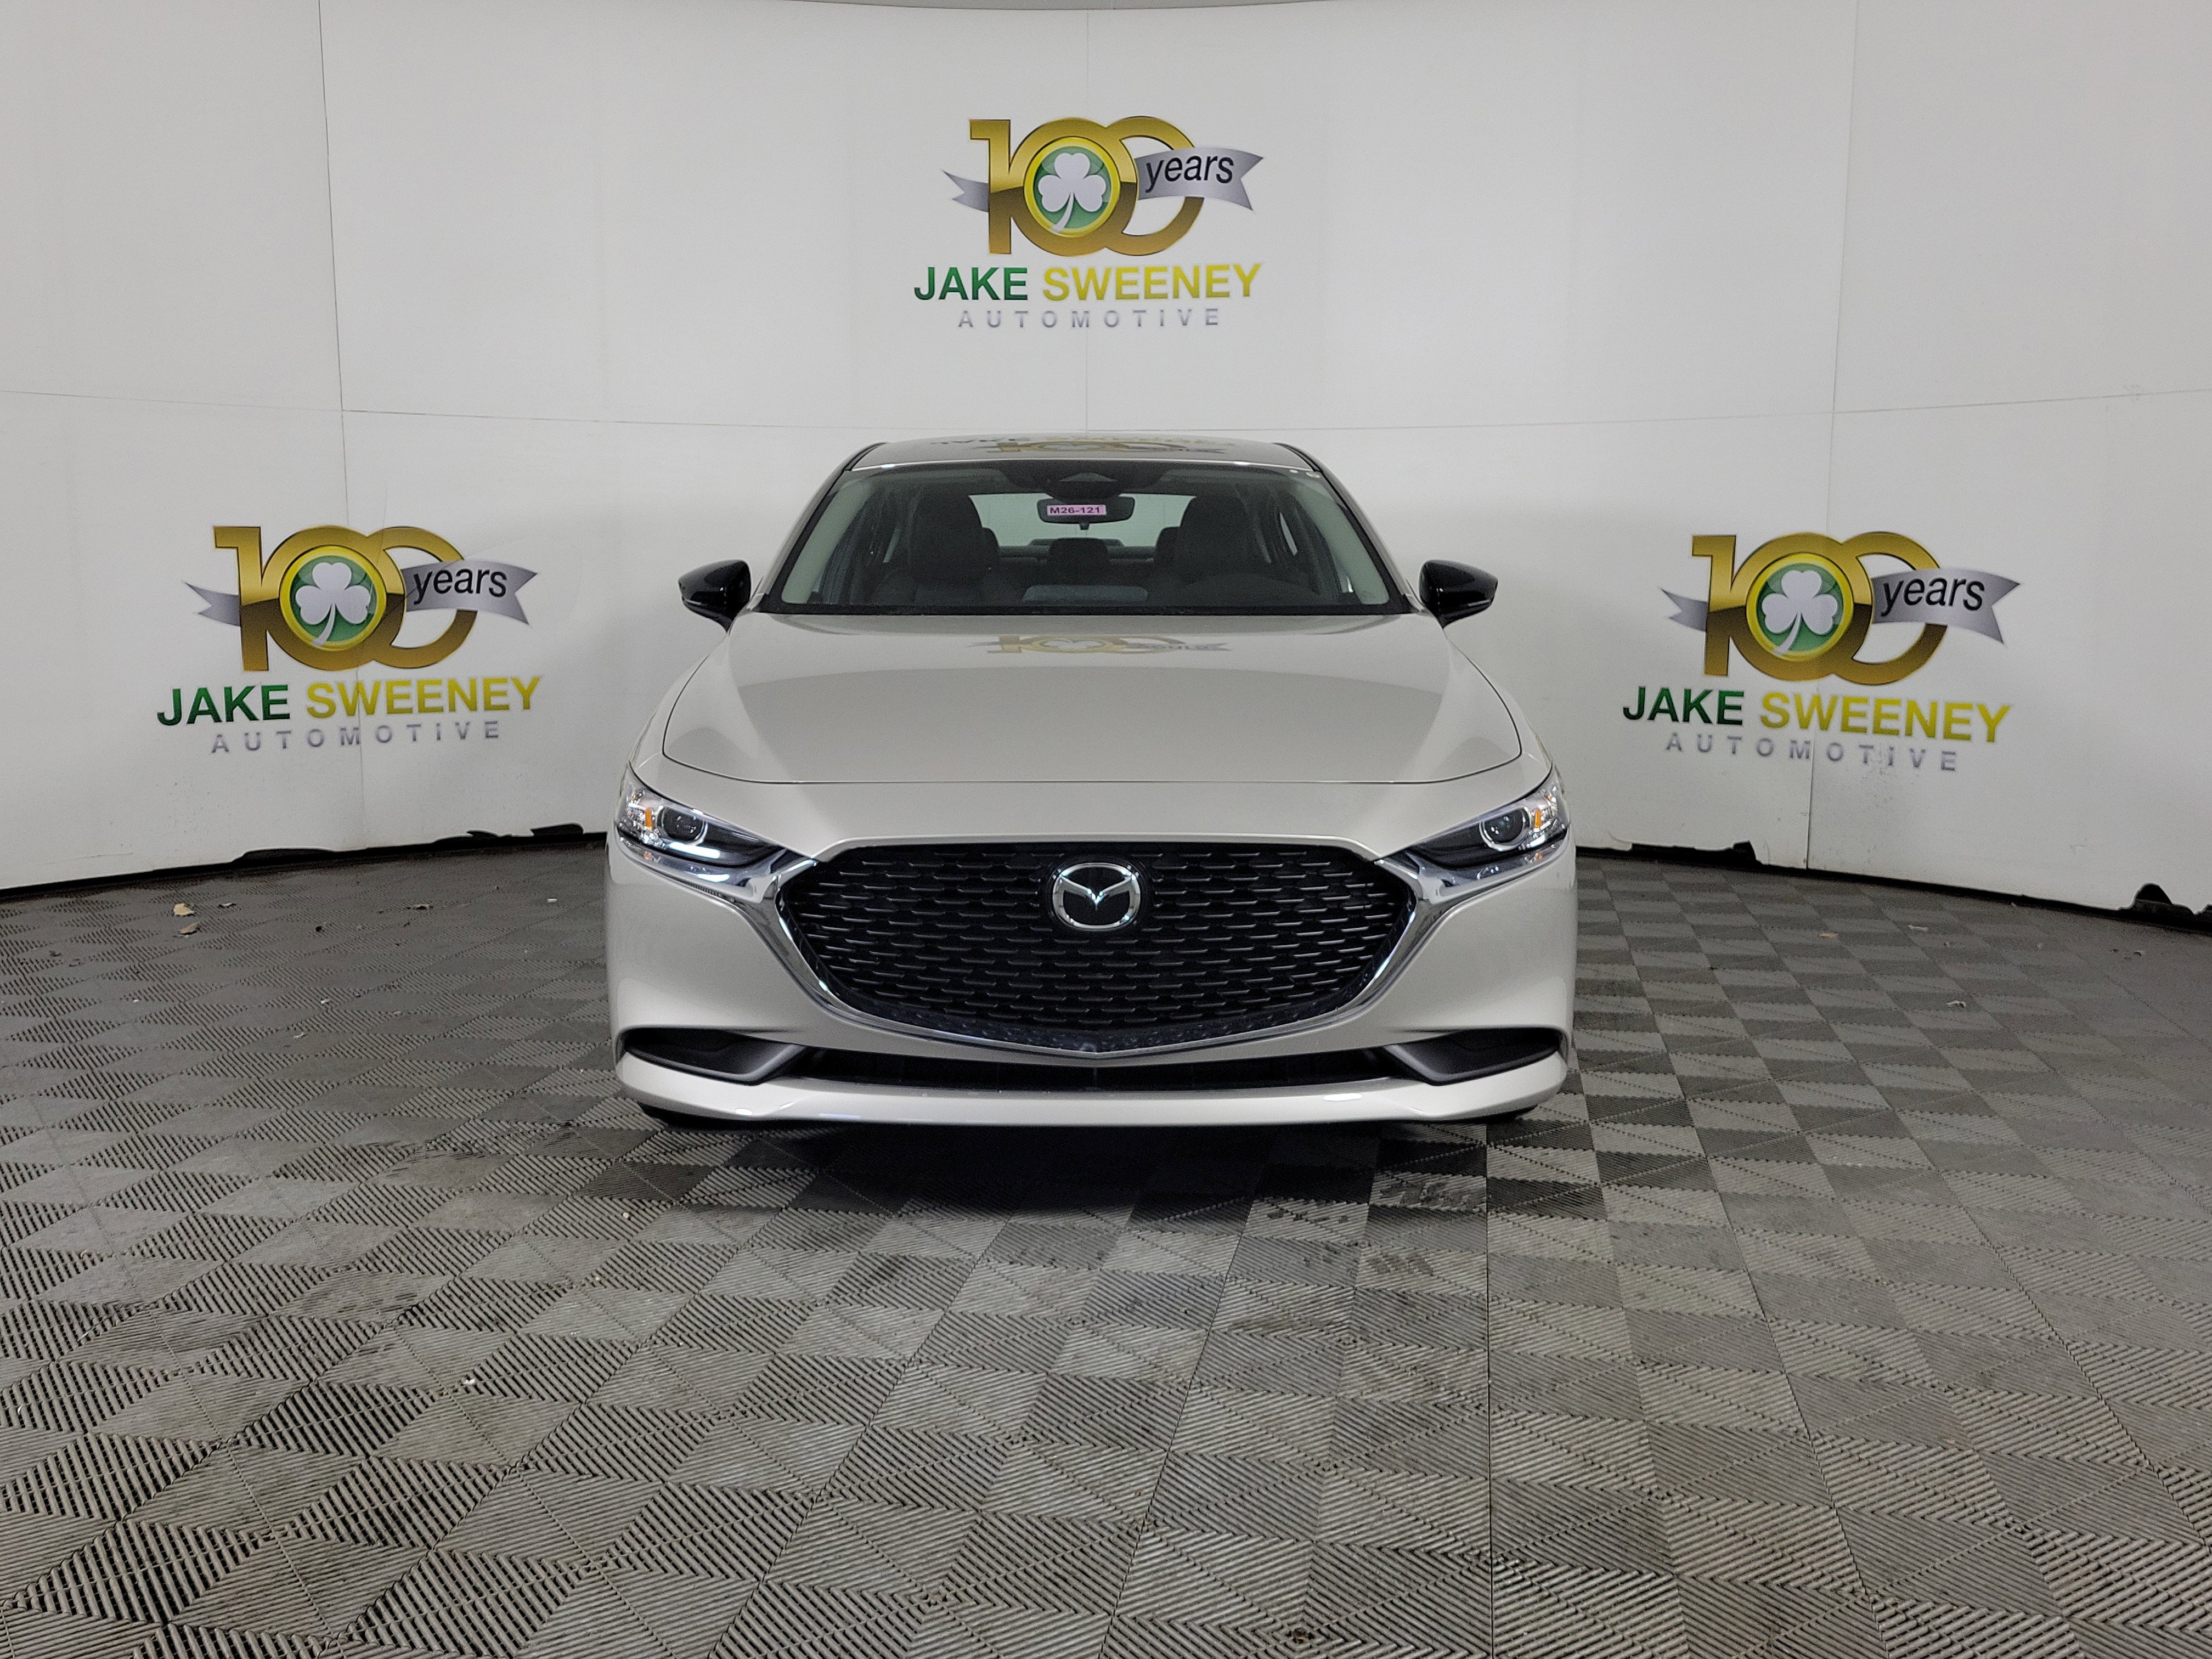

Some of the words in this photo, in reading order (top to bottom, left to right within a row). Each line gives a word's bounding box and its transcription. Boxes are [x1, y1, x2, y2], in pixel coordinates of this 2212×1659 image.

[969, 116, 1205, 257] 100
[1145, 155, 1234, 192] years
[914, 267, 1028, 301] JAKE
[1043, 263, 1261, 301] SWEENEY
[958, 308, 1218, 328] AUTOMOTIVE
[212, 525, 478, 672] 100
[413, 568, 507, 603] years
[1691, 532, 1948, 685] 100
[1880, 577, 1985, 616] years
[157, 684, 290, 726] JAKE
[307, 676, 540, 719] SWEENEY
[1622, 686, 1745, 726] JAKE
[1760, 692, 2011, 743] SWEENEY
[211, 721, 500, 753] AUTOMOTIVE
[1666, 732, 1957, 771] AUTOMOTIVE
